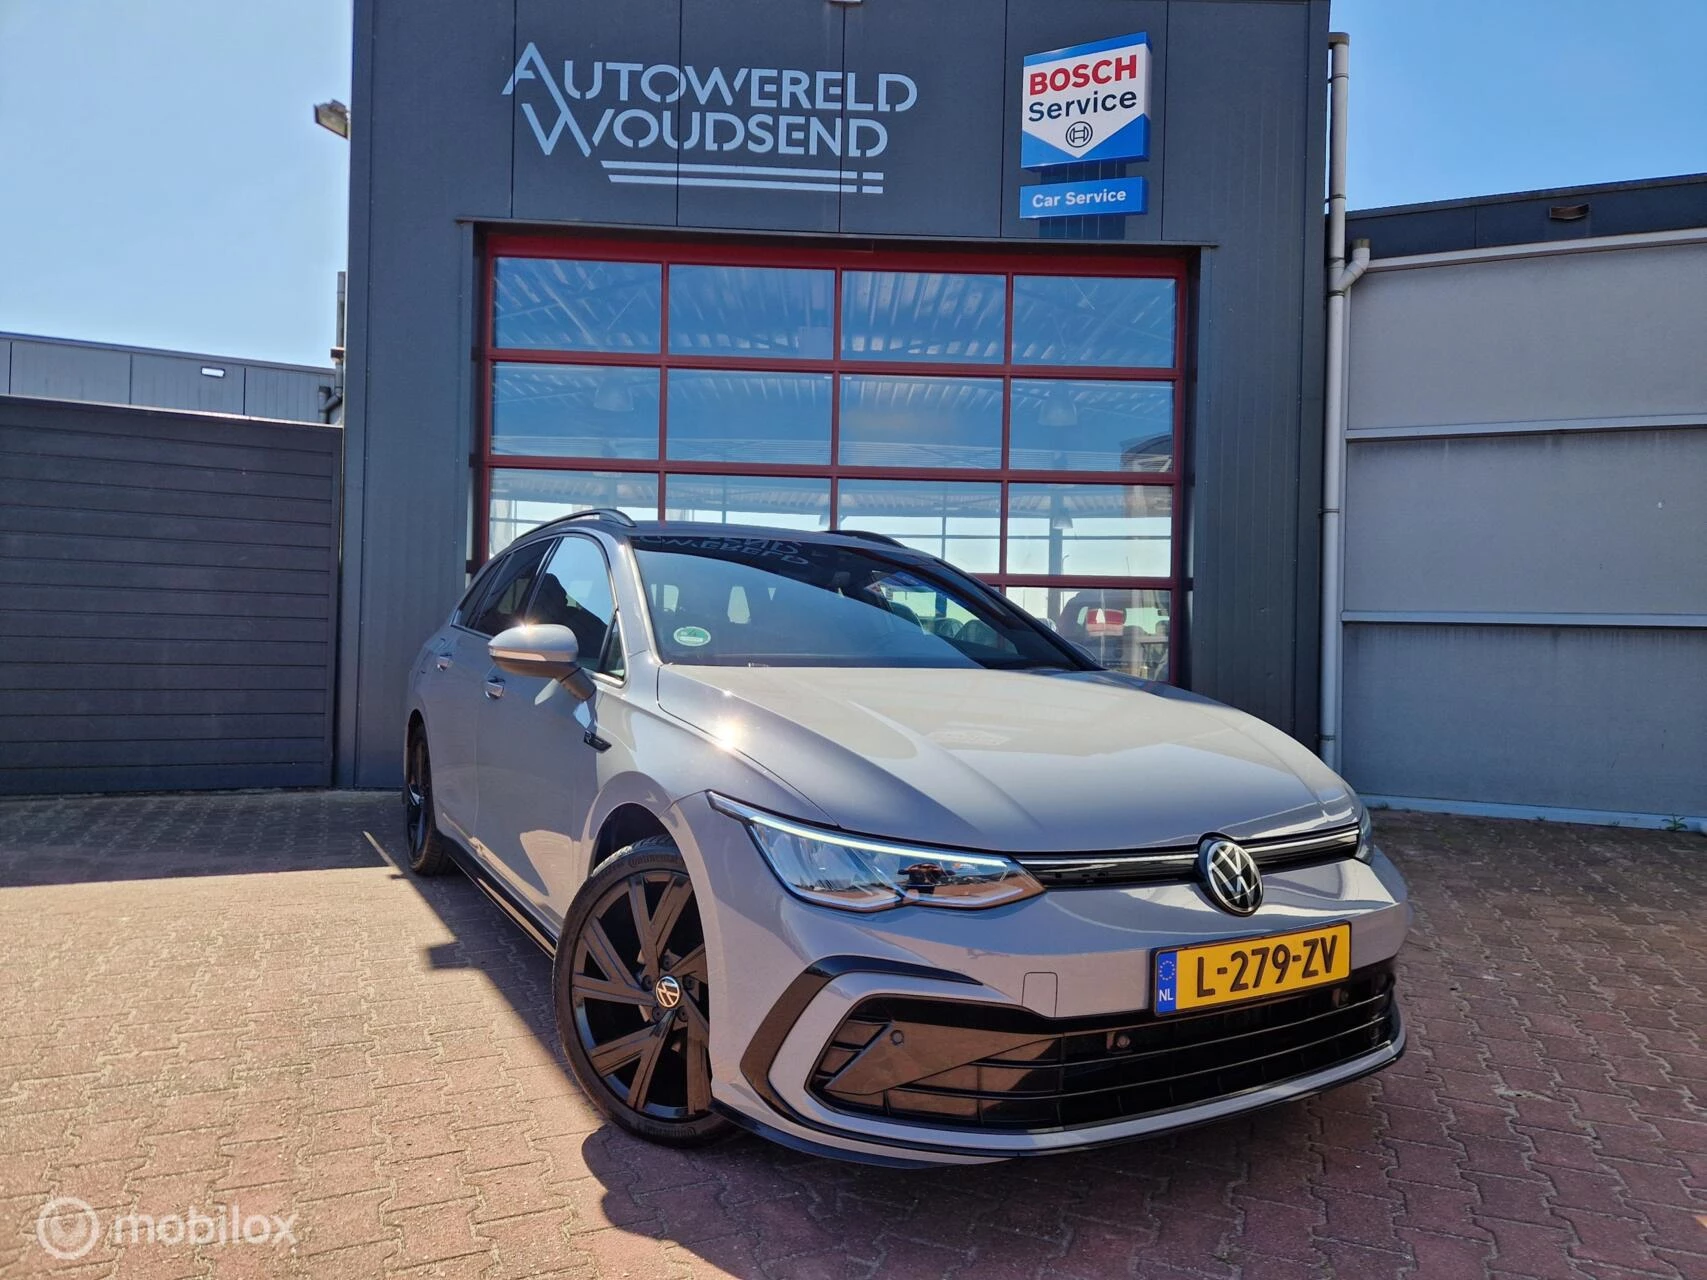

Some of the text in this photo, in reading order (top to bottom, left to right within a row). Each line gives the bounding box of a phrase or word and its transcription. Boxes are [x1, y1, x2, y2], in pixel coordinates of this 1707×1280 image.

[501, 42, 917, 112] AUTOWERELD
[1029, 54, 1137, 96] BOSCH
[1028, 90, 1137, 122] Service
[521, 104, 888, 157] WOUDSEND
[1032, 189, 1127, 208] Car Service
[1197, 935, 1338, 998] L-279-ZV
[1158, 988, 1174, 1001] NL
